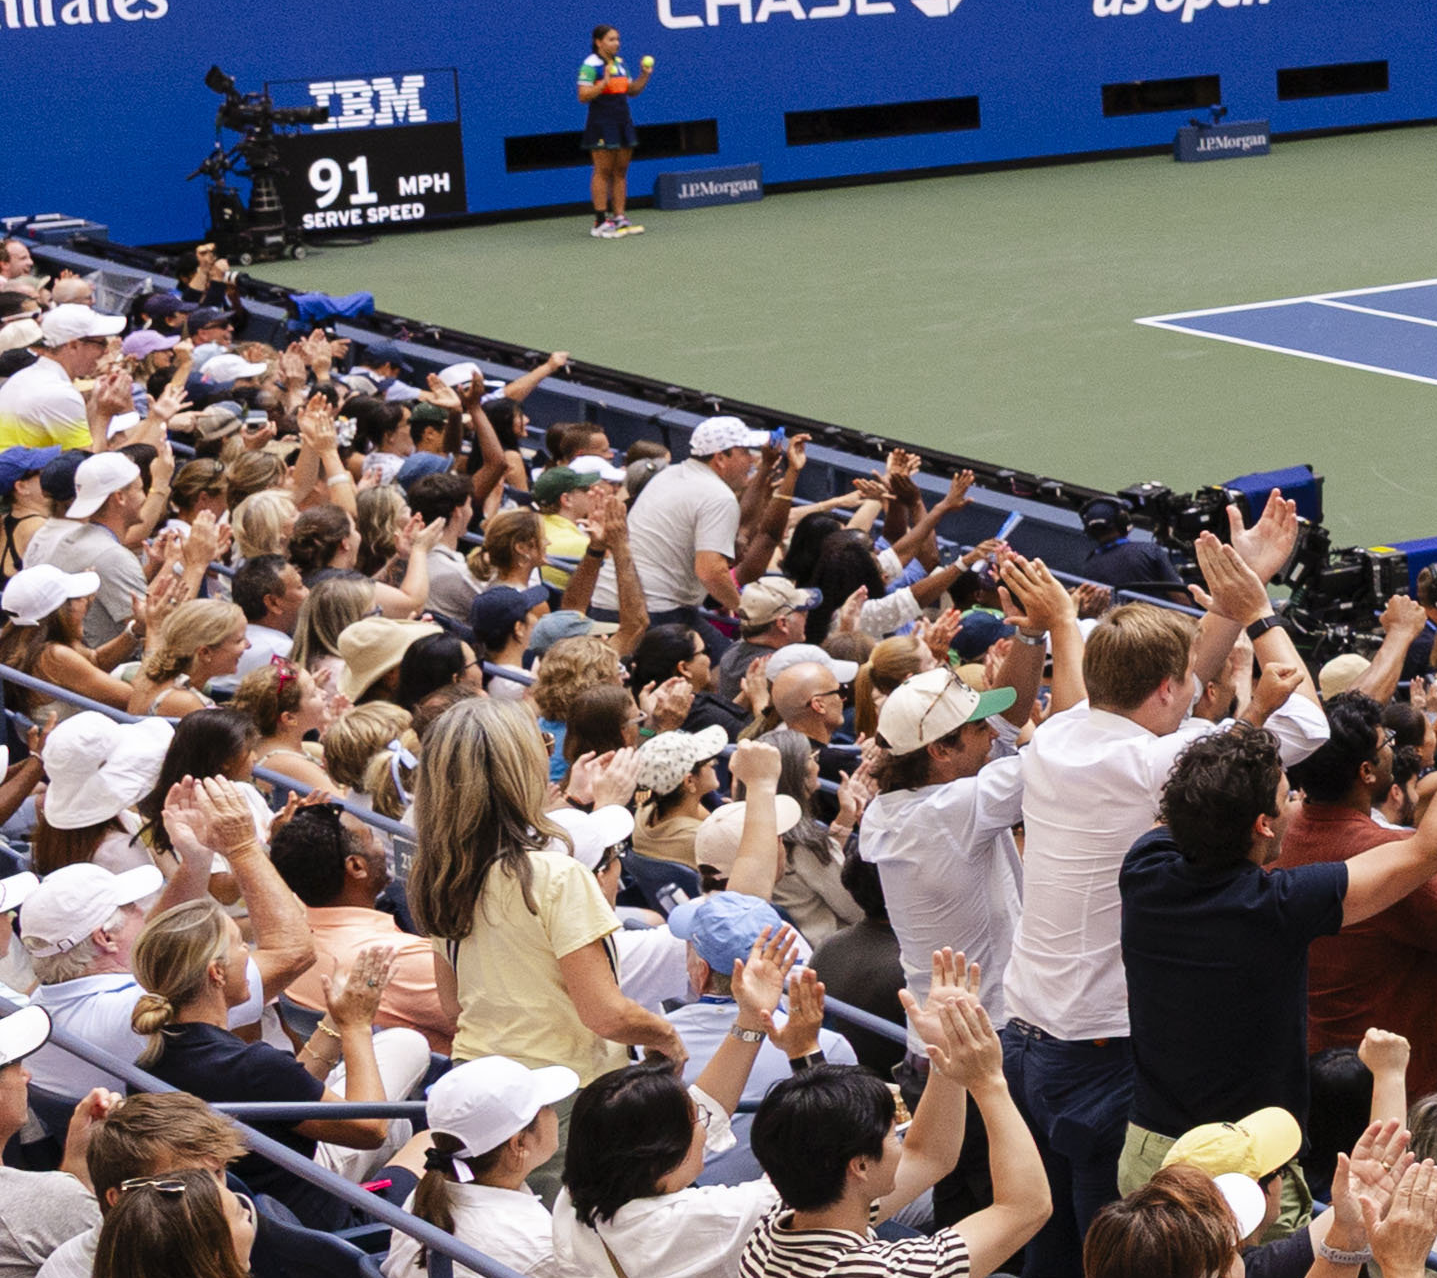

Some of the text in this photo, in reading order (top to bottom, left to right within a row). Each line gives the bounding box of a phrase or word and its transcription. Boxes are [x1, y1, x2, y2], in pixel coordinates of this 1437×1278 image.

[307, 74, 428, 131] IBM
[1196, 134, 1267, 153] J.P.Morgan
[307, 155, 451, 207] 91 MPH
[678, 179, 759, 202] J.P.Morgan
[300, 202, 426, 230] SERVE SPEED
